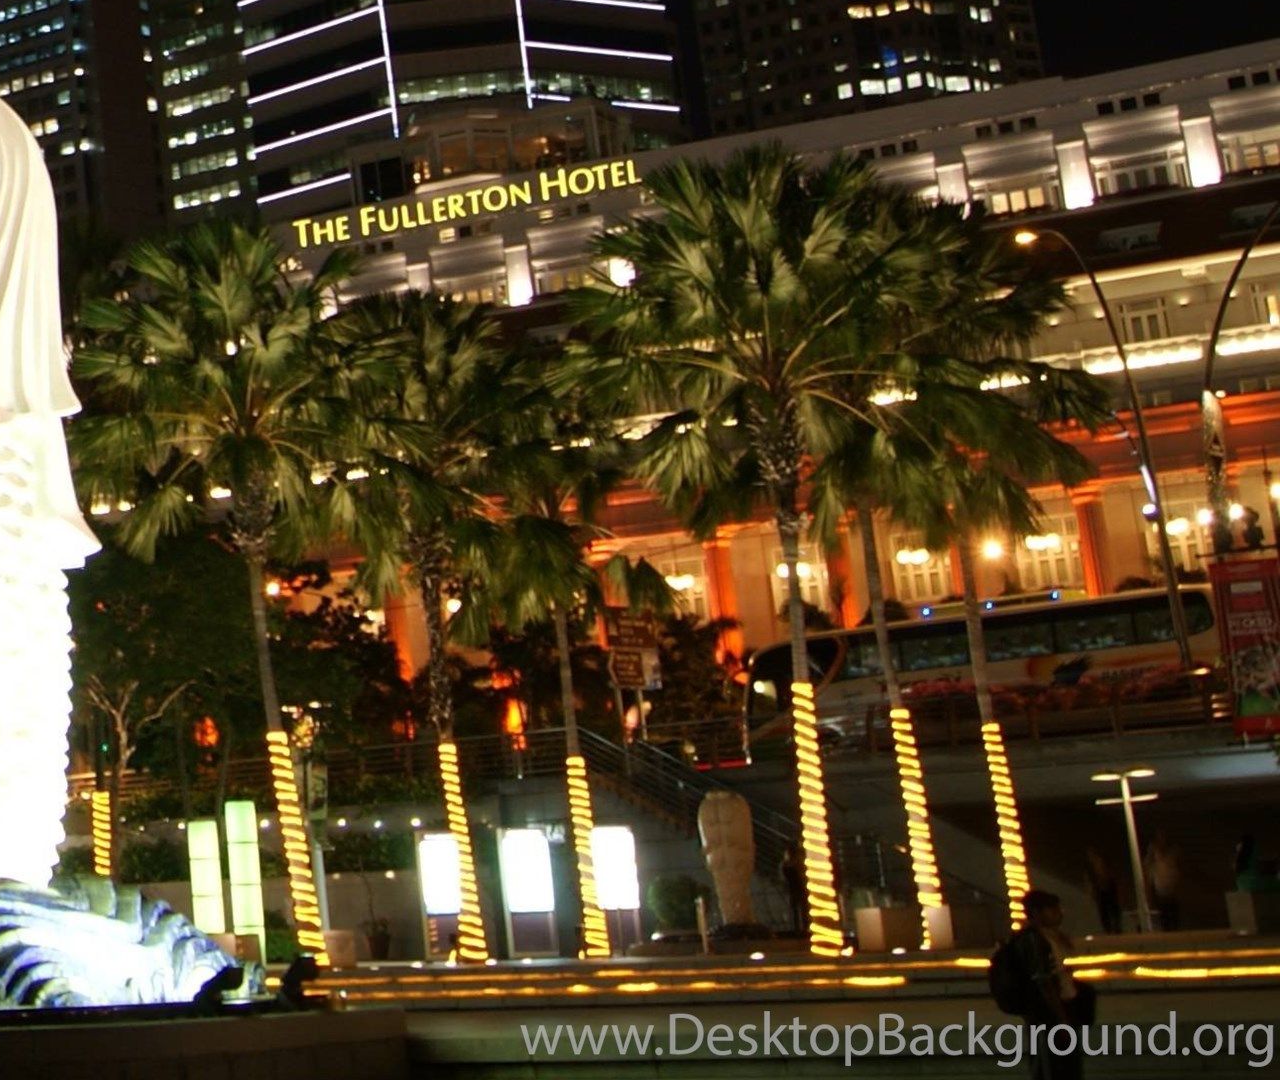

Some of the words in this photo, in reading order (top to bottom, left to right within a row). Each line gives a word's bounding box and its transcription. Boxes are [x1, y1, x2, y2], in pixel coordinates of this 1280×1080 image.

[293, 215, 351, 248] THE
[358, 179, 533, 237] FULLERTON
[539, 159, 643, 203] HOTEL
